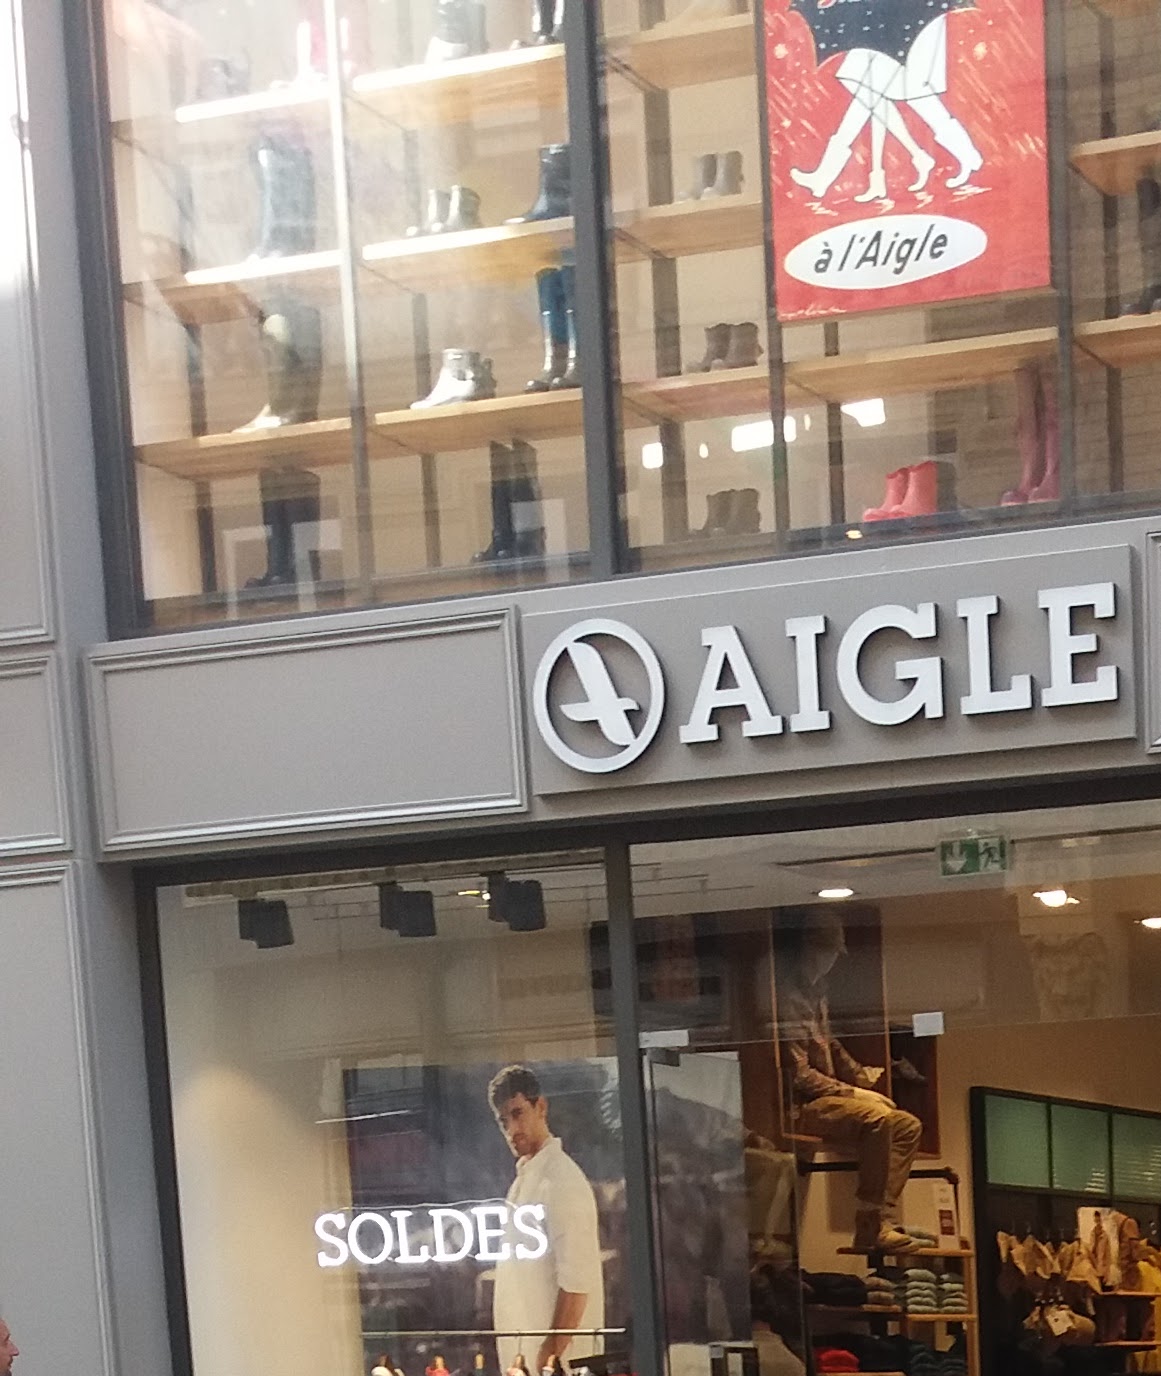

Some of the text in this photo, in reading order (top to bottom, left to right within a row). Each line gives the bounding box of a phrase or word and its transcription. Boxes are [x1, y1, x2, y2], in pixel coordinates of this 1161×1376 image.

[814, 223, 948, 275] à l'Aigle
[679, 582, 1118, 744] AIGLE
[314, 1203, 548, 1267] SOLDES
